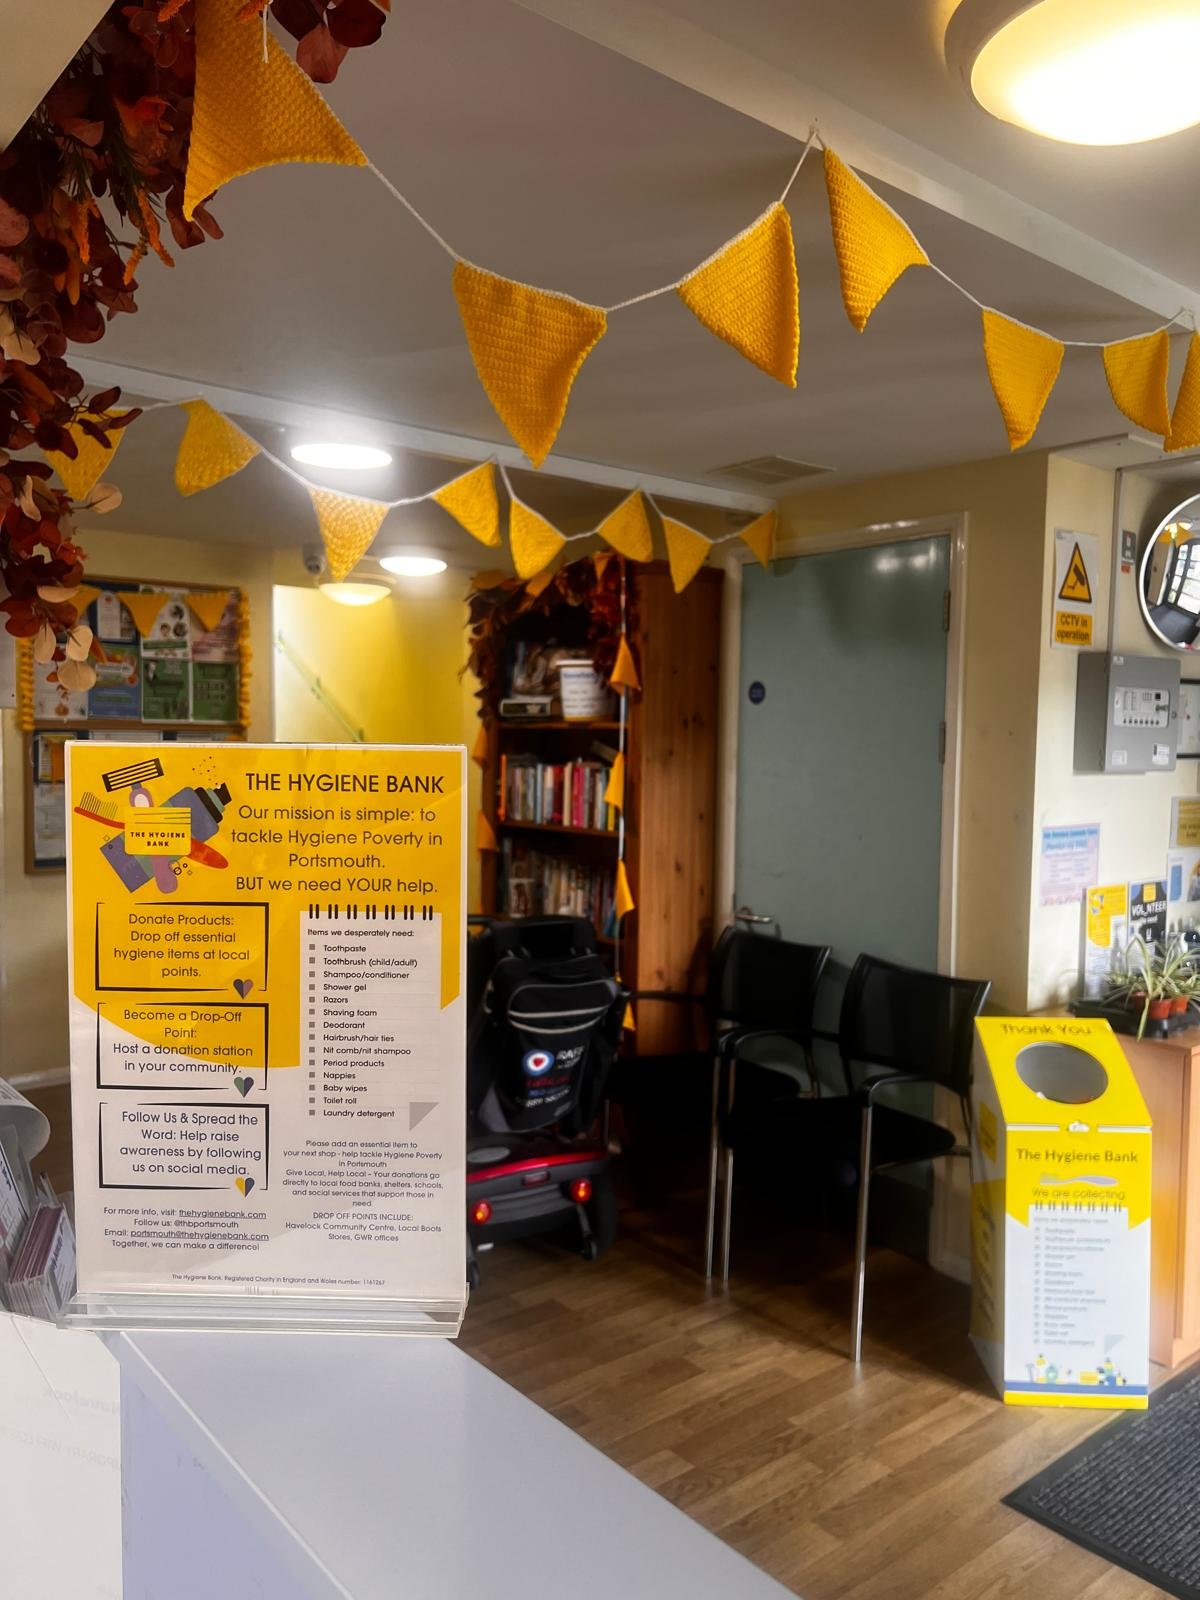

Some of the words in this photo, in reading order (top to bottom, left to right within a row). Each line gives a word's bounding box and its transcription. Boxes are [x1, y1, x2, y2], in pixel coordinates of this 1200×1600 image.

[1060, 613, 1080, 626] CCTV
[1081, 616, 1088, 627] in
[1056, 629, 1090, 642] operation
[245, 773, 281, 791] THE
[288, 774, 379, 793] HYGIENE
[387, 775, 444, 794] BANK
[238, 805, 270, 820] Our
[274, 806, 335, 821] mission
[340, 807, 352, 821] is
[356, 807, 415, 824] simple:
[420, 808, 436, 822] to
[231, 829, 283, 844] tackle
[288, 829, 358, 848] Hygiene
[363, 831, 424, 848] Poverty
[428, 832, 443, 846] in
[289, 853, 385, 868] Portsmouth.
[236, 876, 264, 891] BUT
[268, 880, 293, 891] we
[298, 878, 342, 892] need
[346, 877, 392, 892] YOUR
[397, 879, 438, 896] help.
[129, 913, 175, 925] Donate
[178, 914, 234, 926] Products:
[131, 930, 162, 944] Drop
[164, 931, 180, 942] off
[183, 932, 236, 943] essential
[344, 929, 391, 938] desperately
[114, 947, 165, 962] hygiene
[167, 948, 200, 960] items
[203, 949, 216, 960] at
[219, 949, 250, 961] local
[323, 944, 367, 954] Toothpaste
[323, 957, 367, 966] Toothbrush
[368, 958, 418, 968] (child/adult)
[161, 966, 202, 978] points.
[323, 970, 410, 980] Shampoo/conditioner
[323, 983, 352, 991] Shower
[354, 984, 367, 993] gel
[323, 996, 349, 1004] Razors
[124, 1009, 176, 1021] Become
[178, 1012, 187, 1021] a
[190, 1010, 242, 1024] Drop-Off
[323, 1008, 355, 1018] Shaving
[357, 1009, 378, 1017] foam
[323, 1021, 366, 1029] Deodorant
[1001, 1023, 1052, 1035] Thank
[1060, 1023, 1092, 1035] You
[164, 1027, 197, 1038] Point:
[323, 1033, 380, 1043] Hairbrush/hair
[113, 1043, 139, 1054] Host
[142, 1045, 151, 1054] a
[153, 1044, 210, 1056] donation
[213, 1045, 253, 1056] station
[323, 1046, 334, 1054] Nit
[336, 1046, 372, 1056] comb/nit
[373, 1047, 412, 1056] shampoo
[125, 1060, 136, 1071] in
[138, 1062, 166, 1073] your
[169, 1062, 242, 1076] community.
[323, 1059, 349, 1067] Period
[350, 1060, 385, 1068] products
[323, 1072, 356, 1081] Nappies
[323, 1084, 344, 1093] Baby
[345, 1085, 368, 1093] wipes
[323, 1096, 344, 1104] Toilet
[345, 1097, 357, 1105] roll
[122, 1111, 161, 1123] Follow
[164, 1112, 178, 1124] Us
[180, 1112, 189, 1124] &
[191, 1113, 236, 1126] Spread
[238, 1114, 258, 1126] the
[323, 1109, 355, 1118] Laundry
[356, 1110, 395, 1119] detergent
[141, 1129, 176, 1140] Word:
[180, 1130, 208, 1143] Help
[210, 1131, 240, 1142] raise
[305, 1140, 330, 1148] Please
[331, 1141, 347, 1149] add
[392, 1141, 409, 1149] item
[120, 1147, 185, 1157] awareness
[187, 1146, 204, 1160] by
[206, 1147, 262, 1162] following
[283, 1150, 300, 1158] your
[301, 1150, 317, 1158] next
[318, 1150, 337, 1158] shop
[341, 1150, 359, 1159] help
[384, 1151, 415, 1160] Hygiene
[415, 1151, 443, 1160] Poverty
[1016, 1148, 1041, 1161] The
[1045, 1149, 1100, 1163] Hygiene
[1104, 1150, 1139, 1162] Bank
[132, 1164, 146, 1173] us
[148, 1164, 165, 1173] on
[167, 1163, 203, 1174] social
[207, 1164, 250, 1176] media.
[346, 1160, 388, 1168] Portsmouth
[304, 1169, 327, 1178] Local,
[327, 1170, 345, 1178] Help
[346, 1170, 367, 1179] Local
[373, 1170, 391, 1178] Your
[391, 1172, 428, 1180] donations
[1032, 1188, 1053, 1197] We
[1055, 1189, 1070, 1198] are
[1073, 1188, 1126, 1200] collecting
[103, 1207, 117, 1215] For
[141, 1208, 159, 1216] info,
[179, 1209, 267, 1220] thehygienebank.com
[313, 1212, 335, 1221] DROP
[336, 1212, 351, 1220] OFF
[351, 1213, 378, 1221] POINTS
[379, 1213, 414, 1222] INCLUDE:
[134, 1218, 160, 1226] Follow
[173, 1219, 239, 1229] @thbportsmouth
[285, 1222, 322, 1230] Havelock
[322, 1222, 368, 1232] Community
[368, 1223, 397, 1232] Centre,
[398, 1224, 420, 1232] Local
[104, 1228, 129, 1237] Email:
[130, 1230, 270, 1241] portsmouth@thehygienebank.com
[328, 1233, 353, 1241] Stores,
[354, 1233, 373, 1241] GWR
[374, 1234, 399, 1242] offices
[112, 1239, 150, 1249] Together,
[183, 1242, 207, 1250] make
[208, 1241, 215, 1250] a
[216, 1242, 260, 1251] difference!
